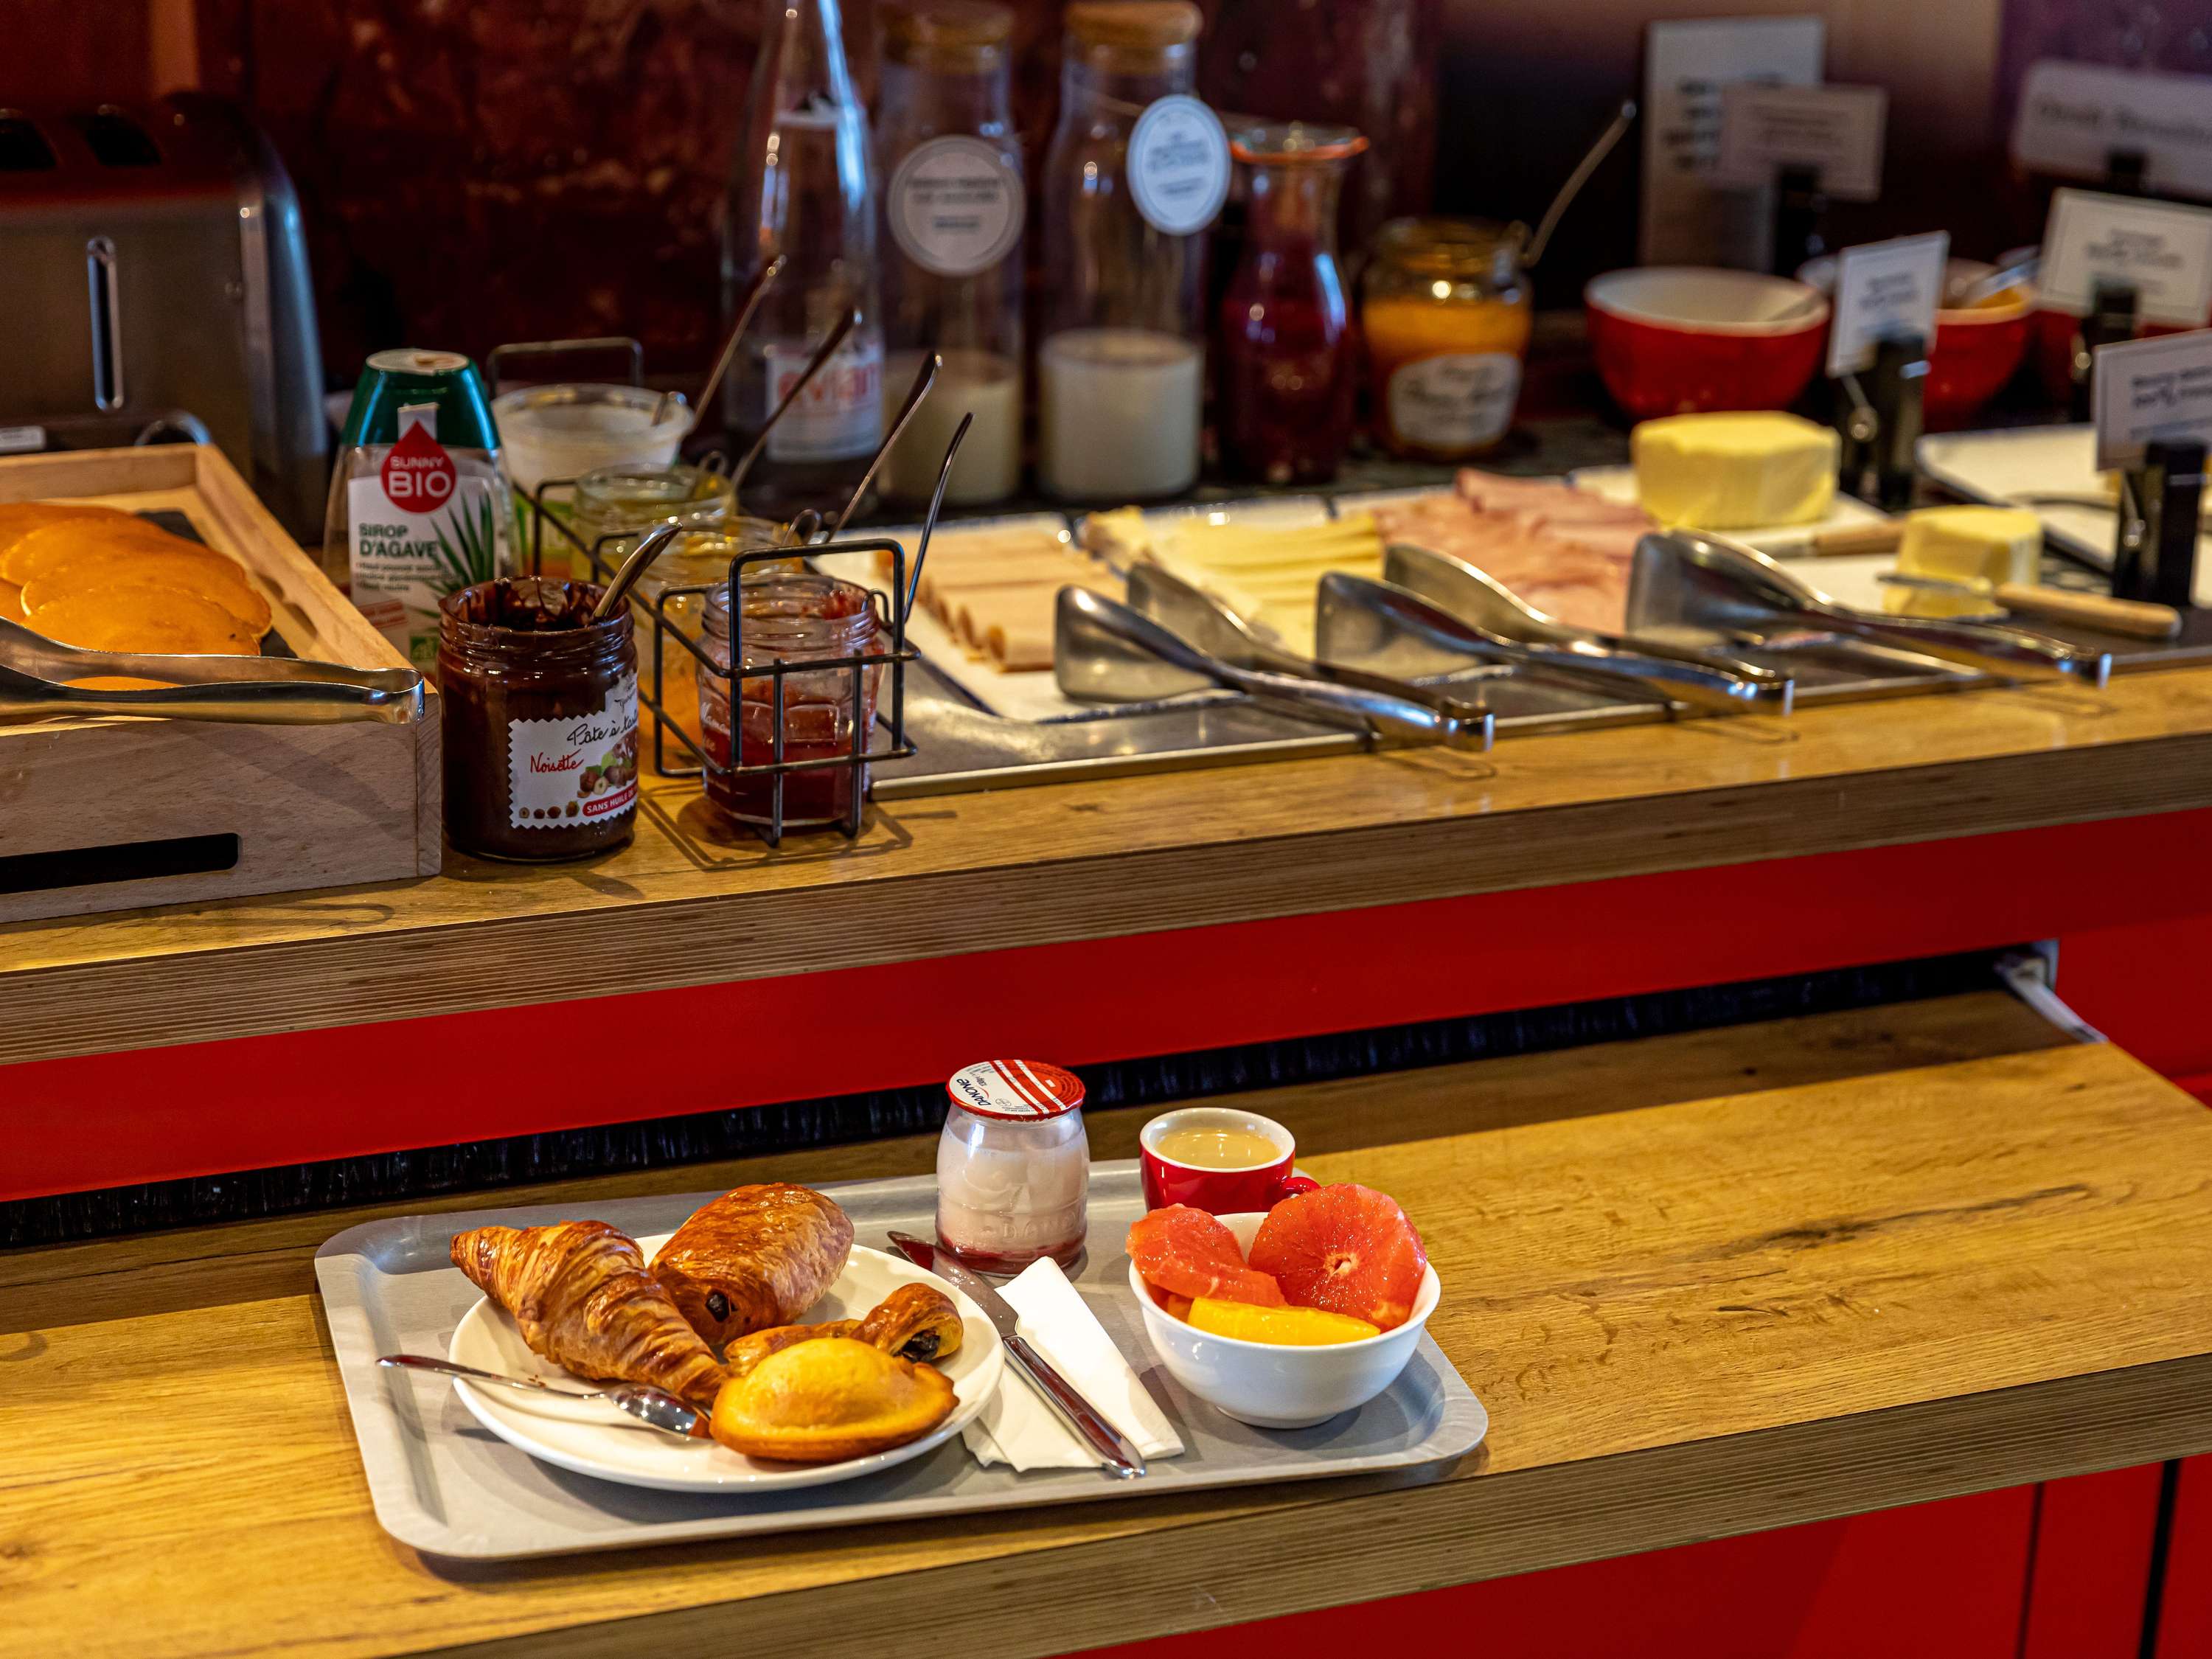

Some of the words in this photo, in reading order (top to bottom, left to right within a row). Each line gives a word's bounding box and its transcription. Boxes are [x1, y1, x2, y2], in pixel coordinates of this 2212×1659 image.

[389, 455, 444, 468] SUNNY
[389, 470, 452, 499] BIO
[358, 522, 410, 539] SIROP
[359, 539, 439, 558] D'AGAVE
[566, 723, 609, 746] Pâte
[529, 748, 585, 773] Noisette
[586, 800, 609, 814] SANS
[609, 792, 628, 807] HUILE
[956, 1078, 992, 1106] DANONE
